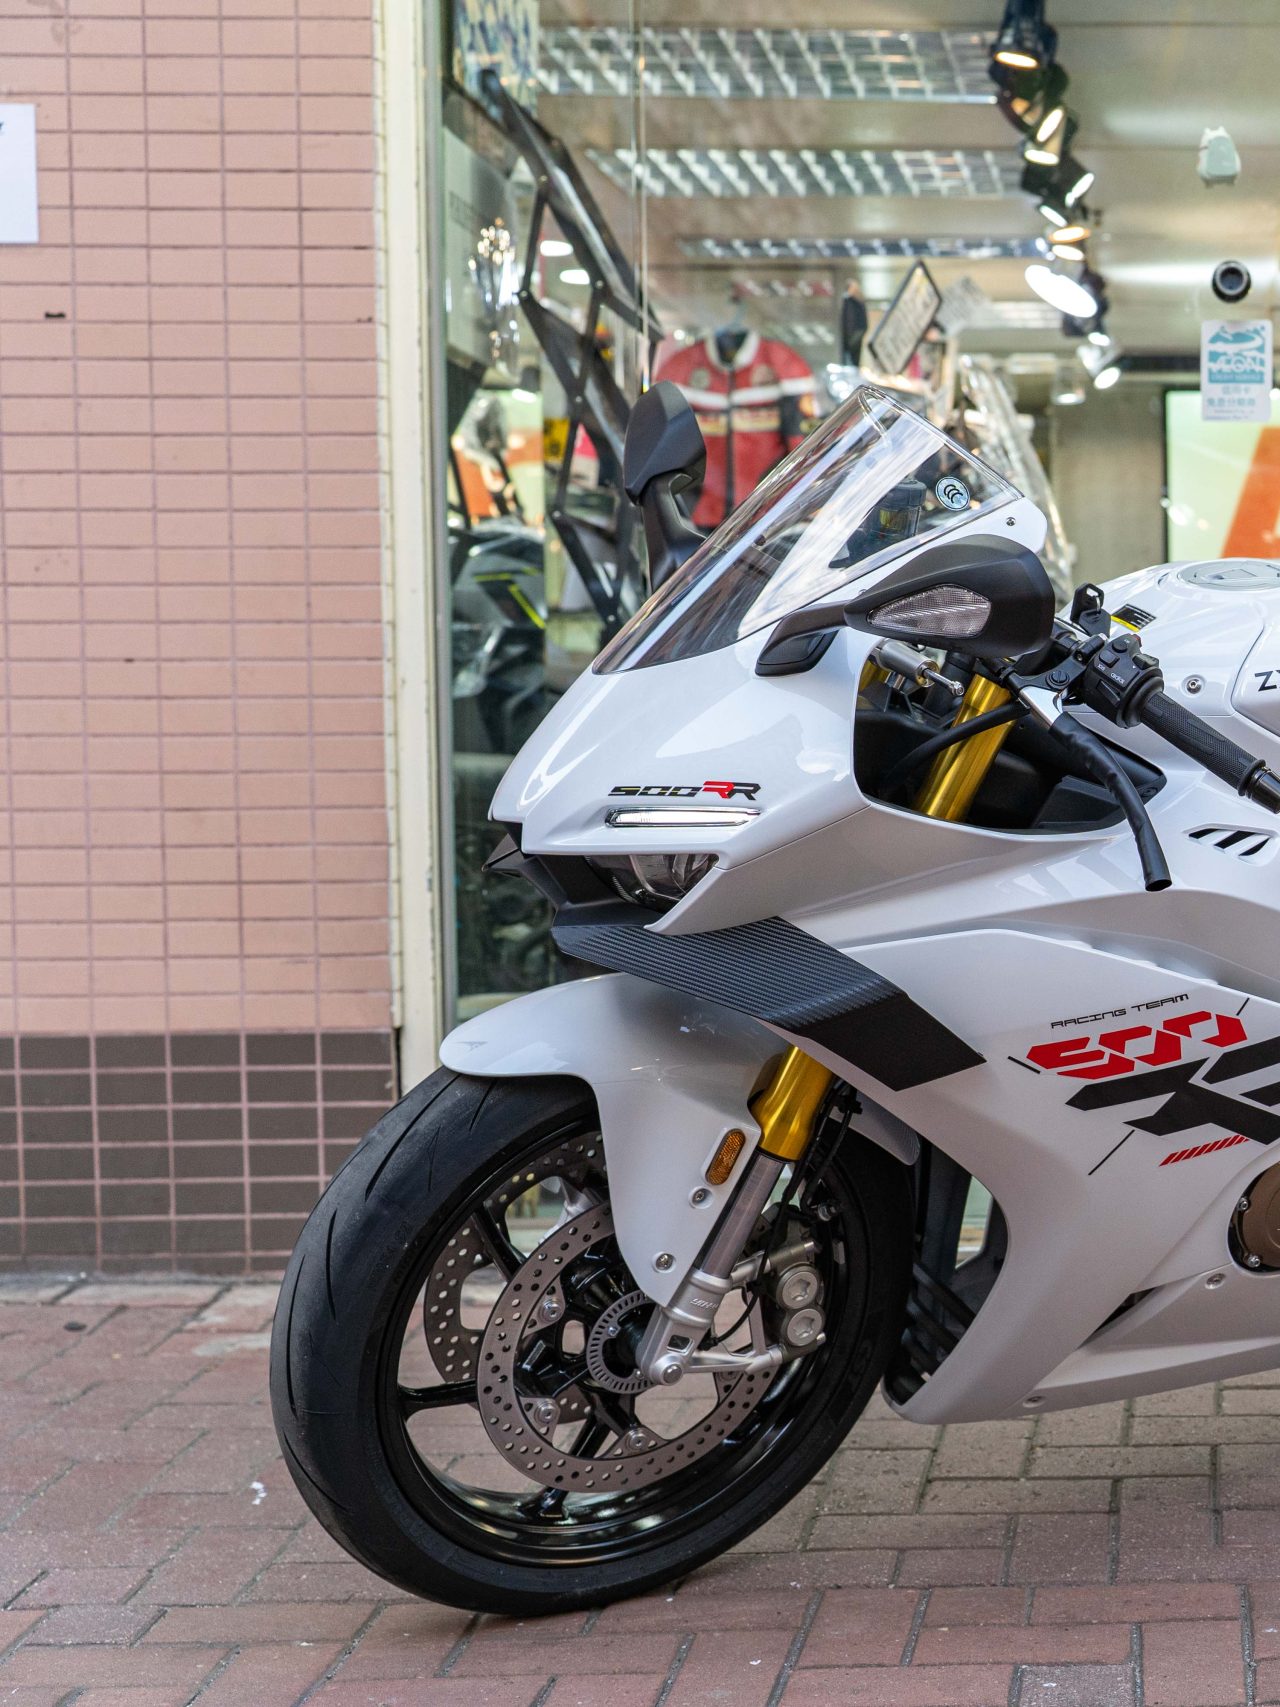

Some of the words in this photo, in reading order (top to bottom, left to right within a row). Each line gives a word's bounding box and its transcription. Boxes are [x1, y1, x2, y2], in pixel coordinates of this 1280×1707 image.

[607, 780, 762, 801] 500RR
[1051, 1007, 1127, 1029] RACING
[1131, 993, 1190, 1013] TEAM
[1026, 1010, 1248, 1080] 500
